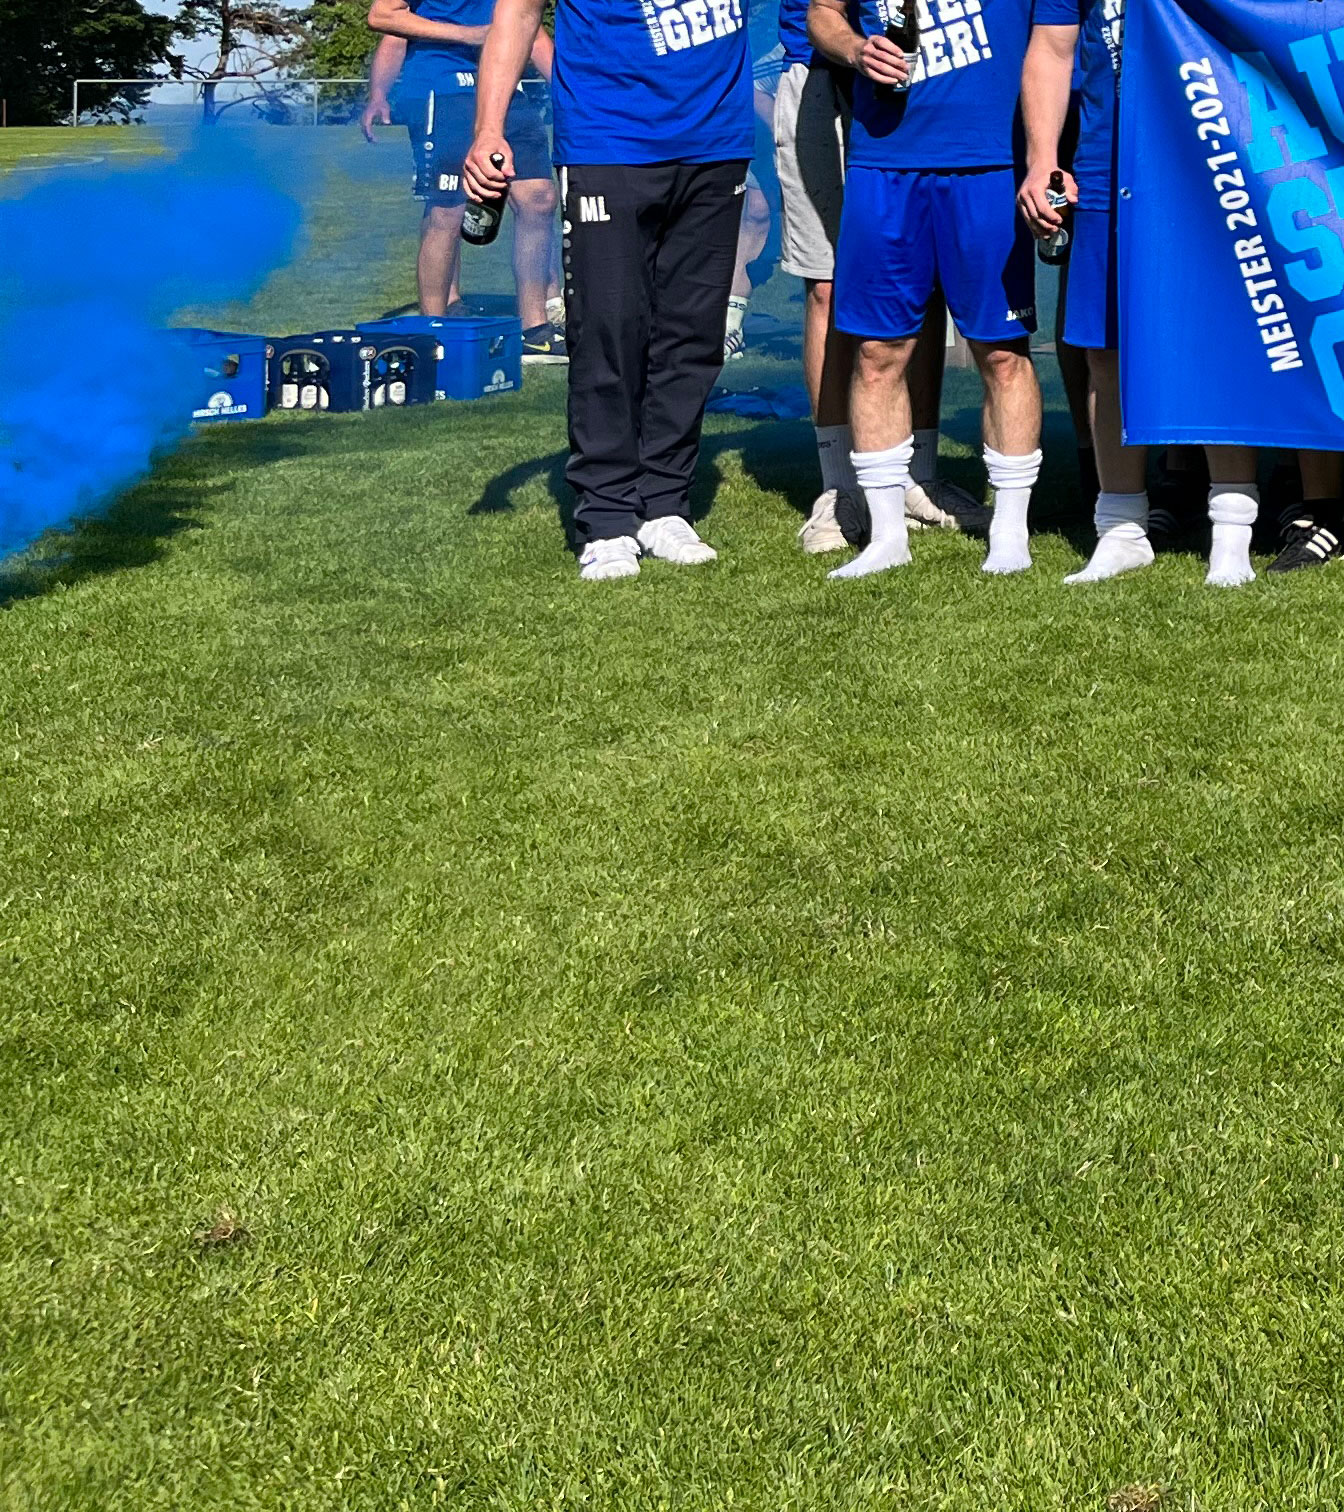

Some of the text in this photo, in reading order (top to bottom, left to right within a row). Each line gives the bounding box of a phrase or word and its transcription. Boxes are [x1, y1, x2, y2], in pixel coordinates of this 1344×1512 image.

[910, 14, 993, 85] ER!
[456, 72, 475, 87] BH
[439, 173, 459, 191] BH
[579, 195, 611, 223] ML
[1179, 57, 1304, 373] MEISTER 2021-2022
